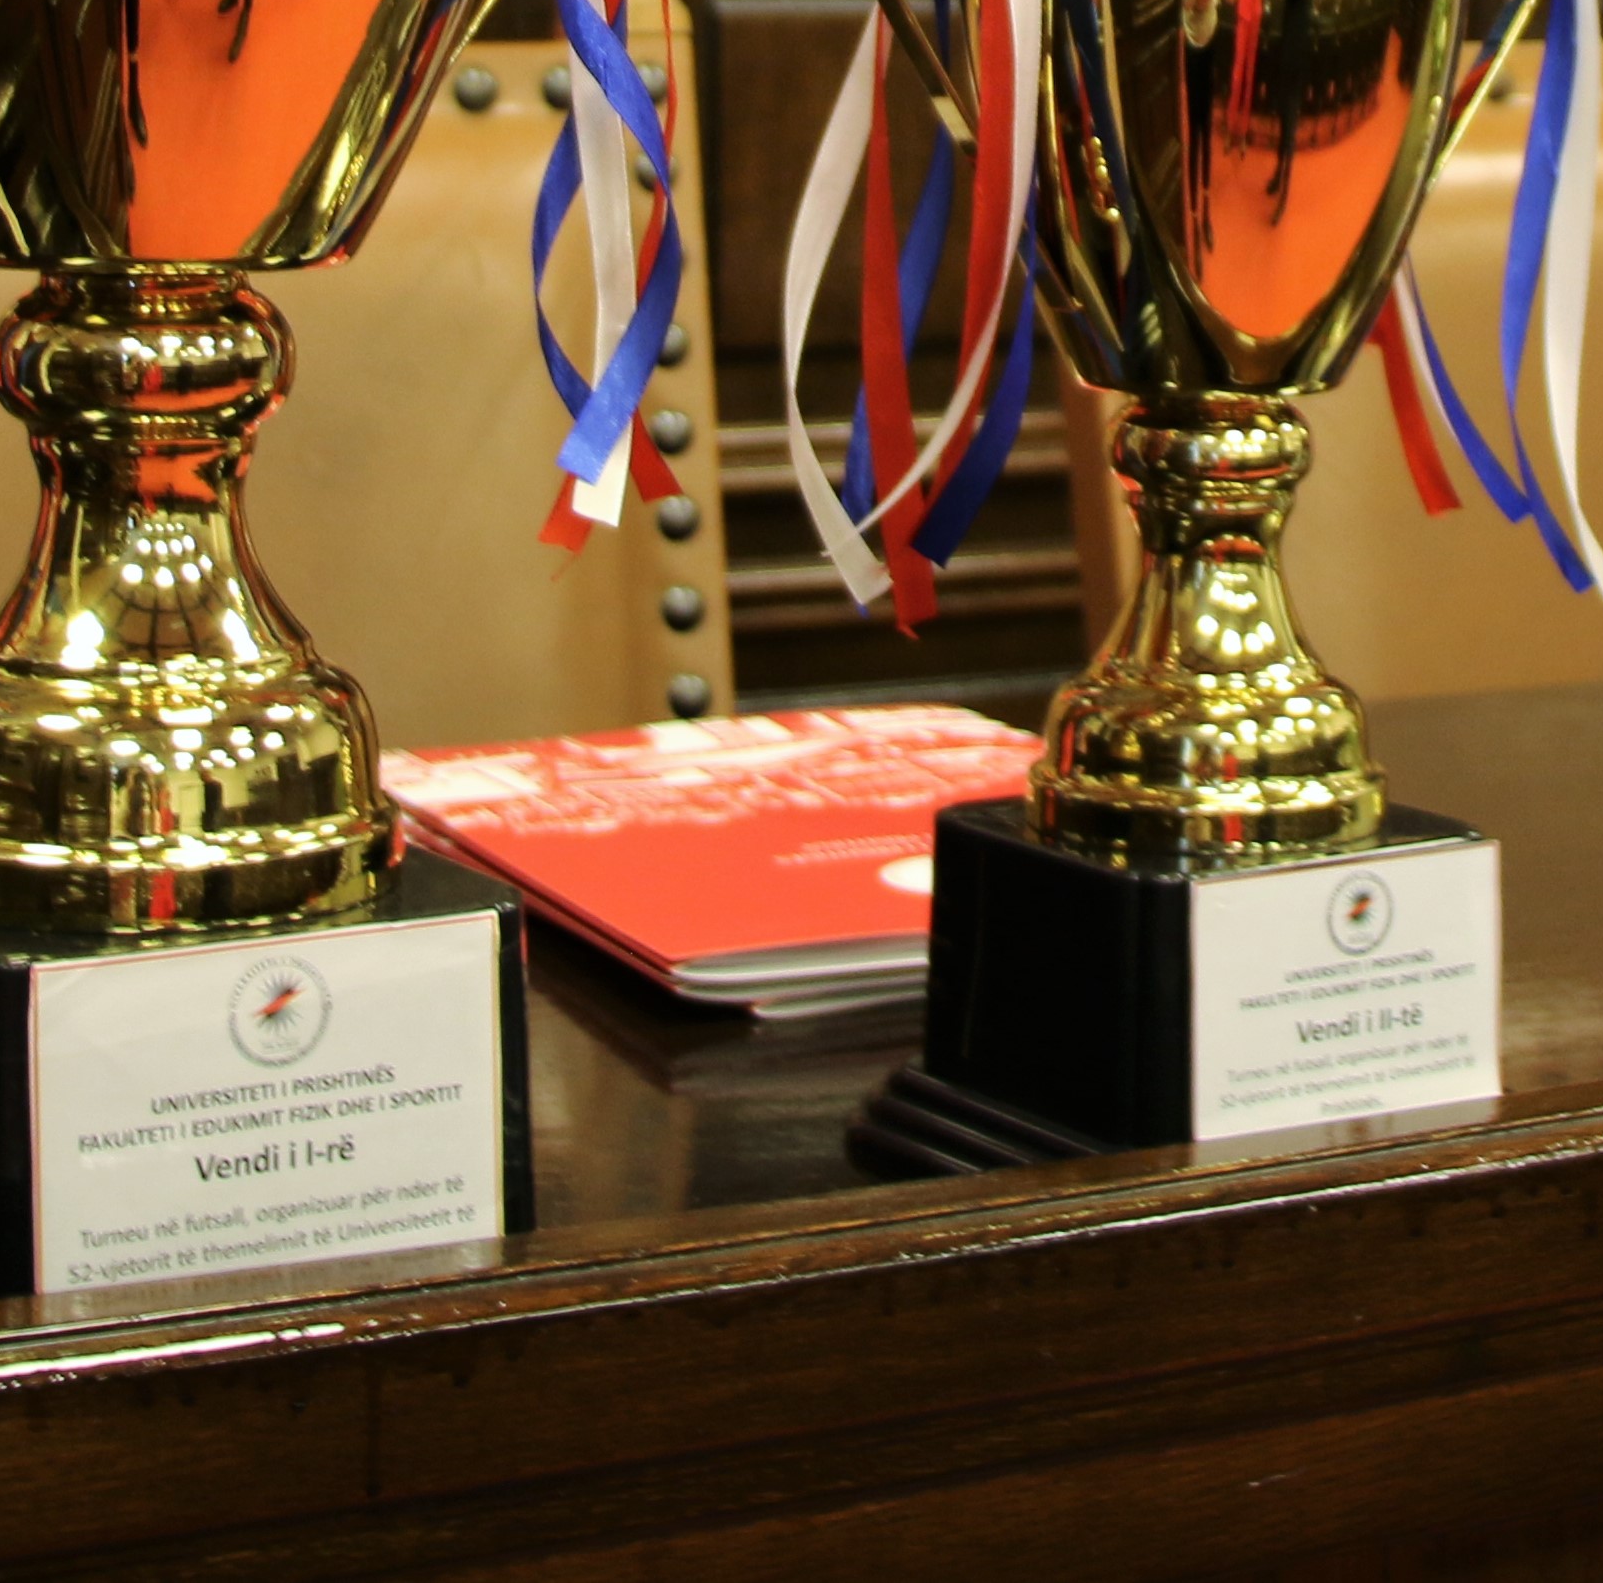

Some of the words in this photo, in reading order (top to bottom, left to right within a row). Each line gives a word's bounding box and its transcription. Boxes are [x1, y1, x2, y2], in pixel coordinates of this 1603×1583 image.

[1295, 1010, 1360, 1043] Vendi
[1366, 1010, 1373, 1032] i
[1379, 1002, 1424, 1031] II-të
[150, 1082, 276, 1115] UNIVERSITETI
[292, 1063, 396, 1094] PRISHTINËS
[78, 1124, 175, 1153] FAKULTETI
[191, 1109, 283, 1138] EDUKIMIT
[289, 1102, 333, 1124] FIZIK
[337, 1096, 374, 1117] DHE
[390, 1083, 463, 1110] SPORTIT
[195, 1142, 280, 1182] Vendi
[289, 1141, 296, 1169] i
[306, 1133, 355, 1167] I-rë
